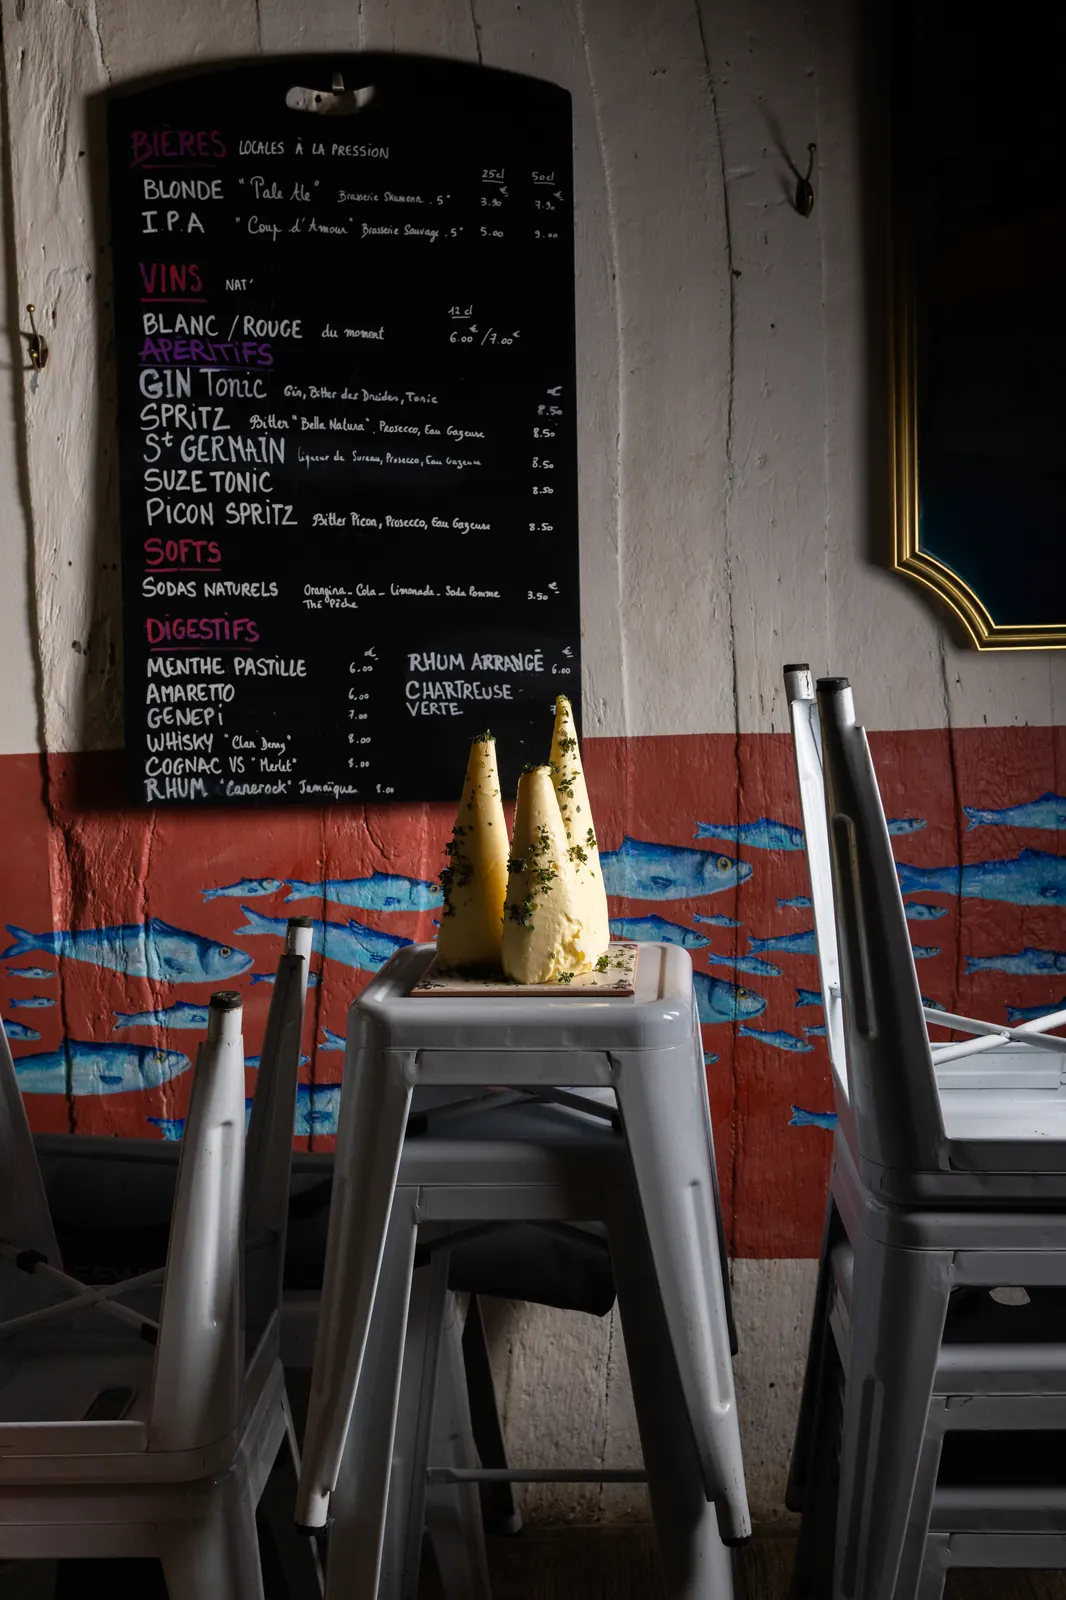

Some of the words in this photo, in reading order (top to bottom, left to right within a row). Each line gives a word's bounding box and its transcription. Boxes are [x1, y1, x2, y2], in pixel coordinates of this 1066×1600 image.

[129, 124, 228, 169] BIÈRES
[239, 140, 284, 155] LOCALES
[296, 137, 303, 155] À
[312, 143, 325, 155] LA
[144, 179, 224, 200] BLONDE
[361, 223, 399, 238] Brasserie
[404, 224, 439, 242] Sauvage
[140, 263, 202, 293] VINS
[143, 313, 218, 336] BLANC
[322, 324, 338, 337] du
[344, 327, 384, 340] moment
[139, 367, 191, 399] GIN
[309, 386, 337, 398] Bitter
[341, 388, 358, 400] des
[405, 392, 438, 403] Tonic
[250, 414, 289, 429] Bitter
[425, 425, 441, 434] Eau
[534, 428, 555, 438] 8.50
[143, 432, 173, 462] St
[334, 450, 345, 461] de
[426, 455, 442, 465] Eau
[532, 457, 554, 469] 8.50
[144, 468, 207, 493] SUZE
[312, 512, 346, 526] Bitter
[431, 517, 449, 528] Eau
[453, 518, 490, 534] Gazeuse
[529, 523, 553, 531] 8.50
[144, 538, 221, 565] SOFTS
[142, 576, 196, 597] SODAS
[204, 581, 278, 597] NATURELS
[356, 583, 376, 596] Cola
[391, 583, 434, 596] Limonade
[446, 586, 466, 596] Soda
[148, 657, 225, 677] MENTHE
[350, 662, 373, 673] 6.00
[408, 652, 465, 672] RHUM
[552, 664, 570, 674] 6.00
[146, 683, 235, 706] AMARETTO
[406, 680, 513, 699] CHARTREUSE
[349, 710, 367, 719] 7.00
[406, 701, 463, 716] VERTE
[348, 733, 371, 744] 8.00
[145, 756, 222, 778] COGNAC
[229, 756, 245, 773] VS
[144, 777, 208, 802] RHUM
